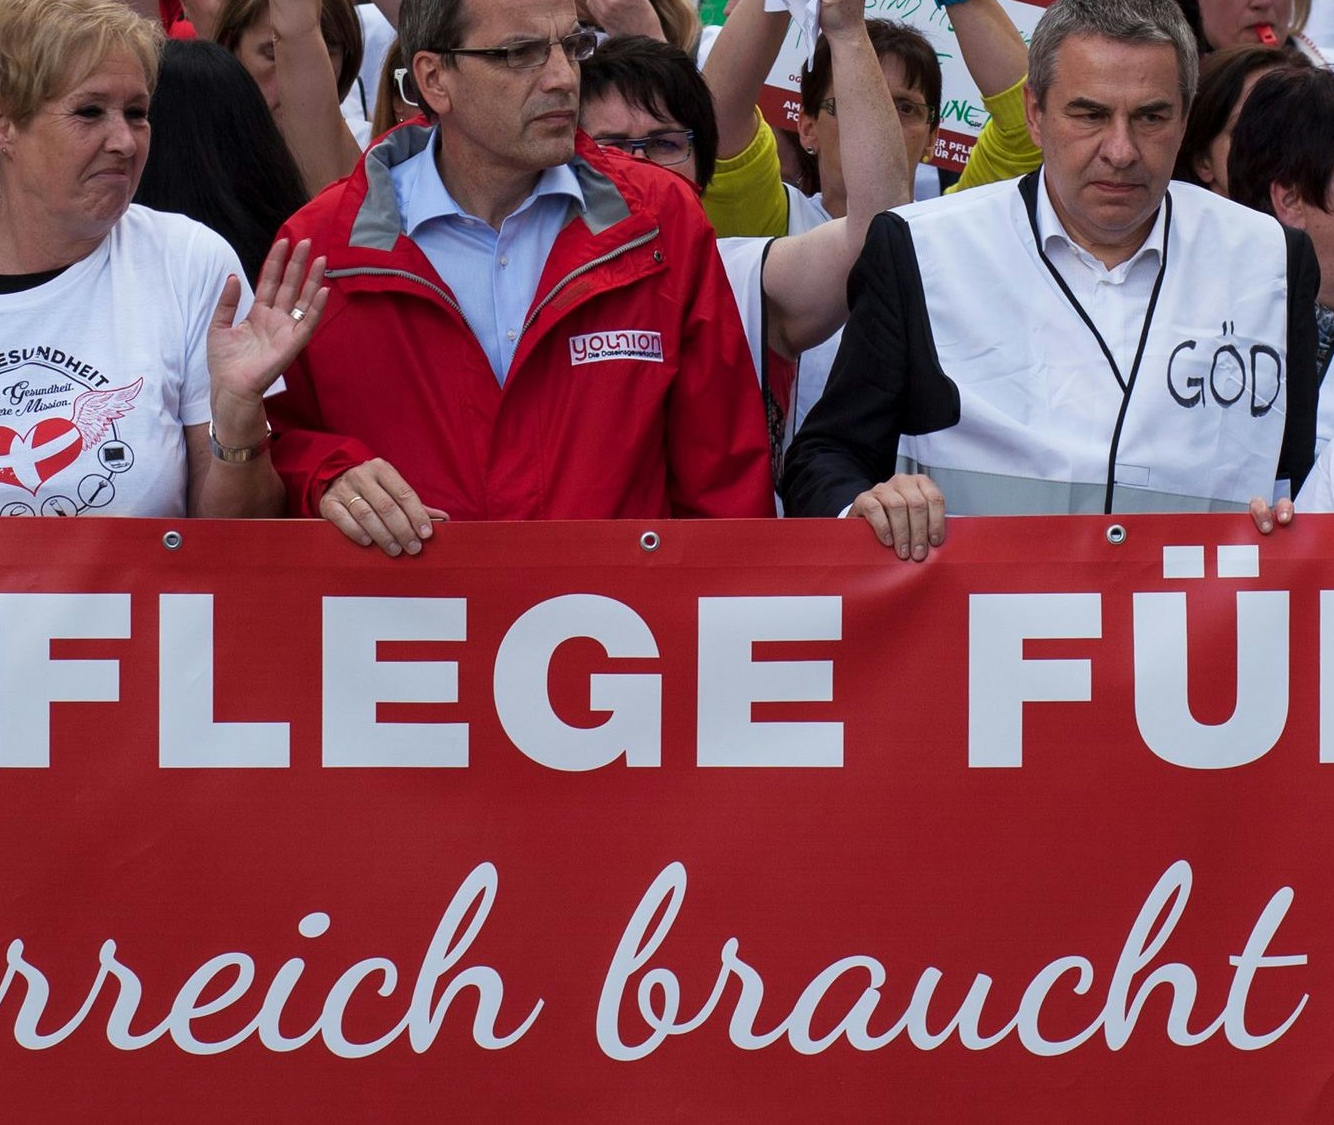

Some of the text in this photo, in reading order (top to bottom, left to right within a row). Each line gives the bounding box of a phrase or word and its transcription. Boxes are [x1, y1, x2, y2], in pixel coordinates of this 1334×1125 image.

[572, 333, 661, 361] younion
[1167, 320, 1282, 418] GÖD
[3, 381, 75, 406] Gesundheit.
[16, 398, 72, 417] Mission.
[596, 860, 1310, 1061] braucht
